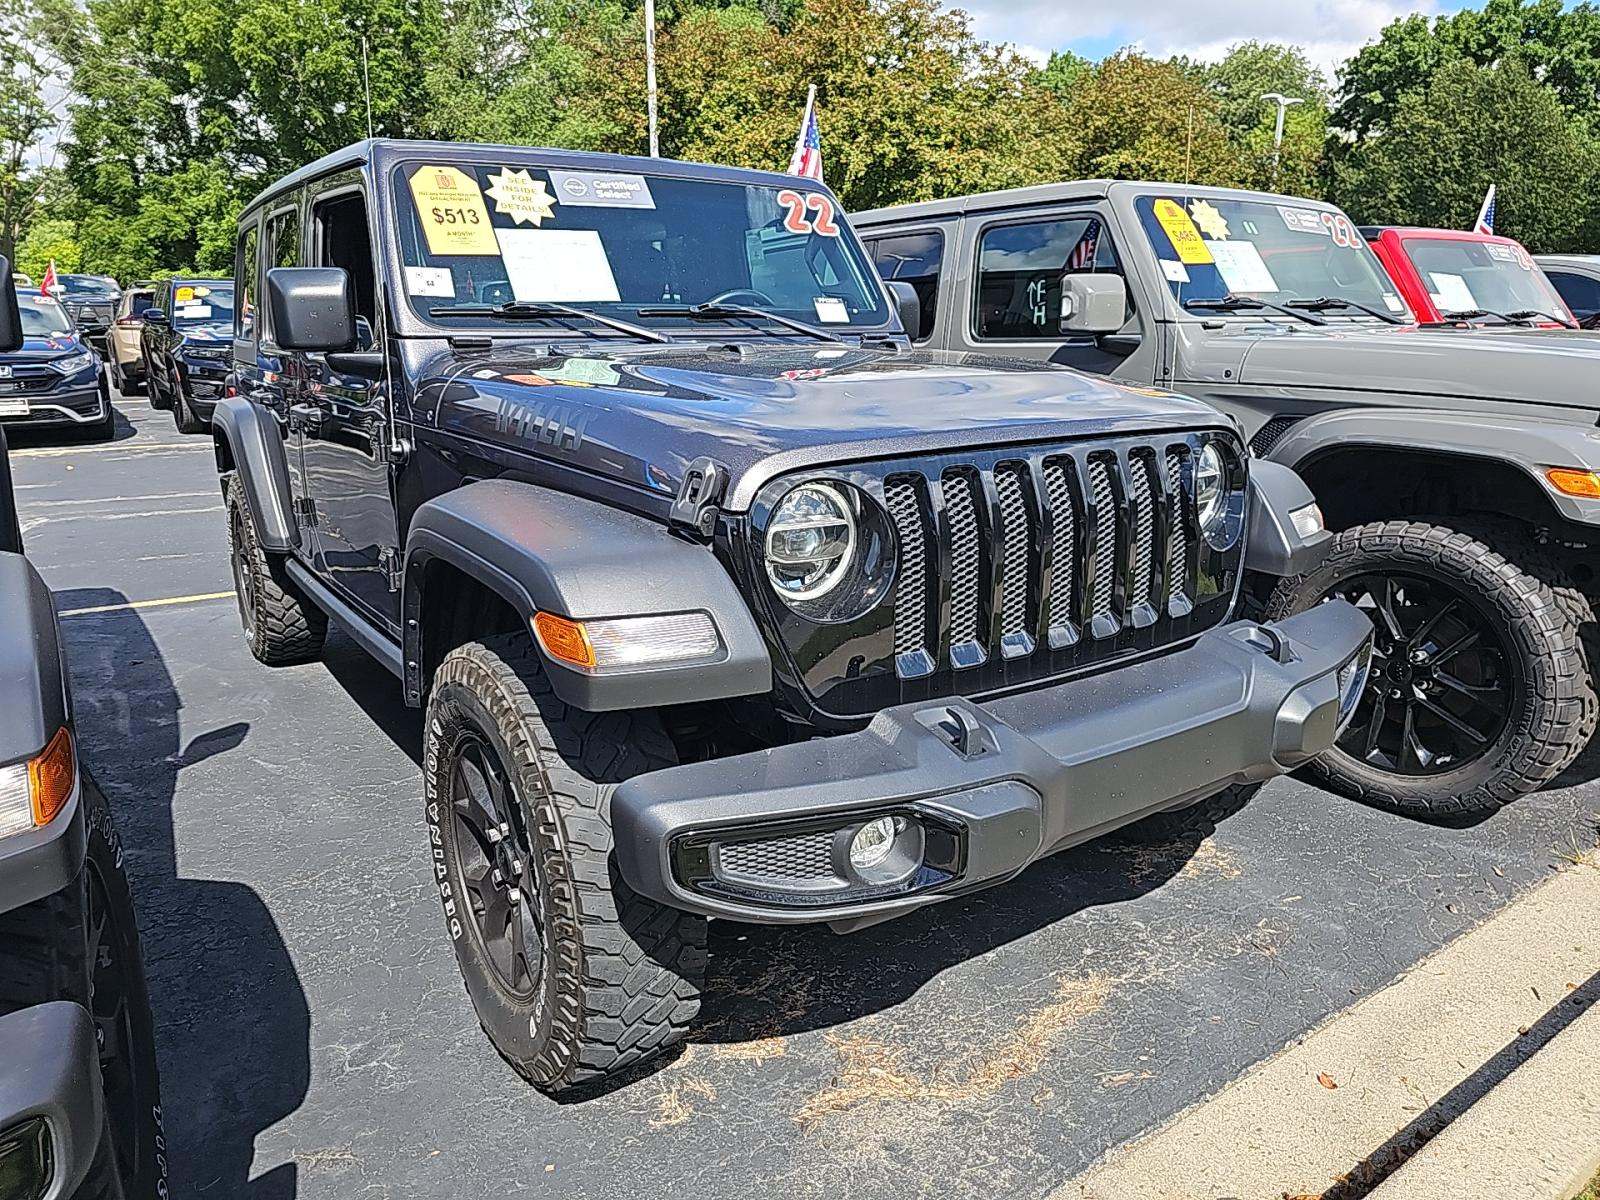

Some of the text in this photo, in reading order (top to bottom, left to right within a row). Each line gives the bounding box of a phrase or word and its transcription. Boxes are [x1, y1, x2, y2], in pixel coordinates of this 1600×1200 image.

[502, 186, 537, 194] INSIDE
[507, 177, 527, 185] SEE
[511, 195, 532, 203] FOR
[431, 205, 480, 225] $513
[777, 189, 840, 236] 22
[1320, 212, 1363, 249] 22
[427, 731, 463, 941] DESTINATION
